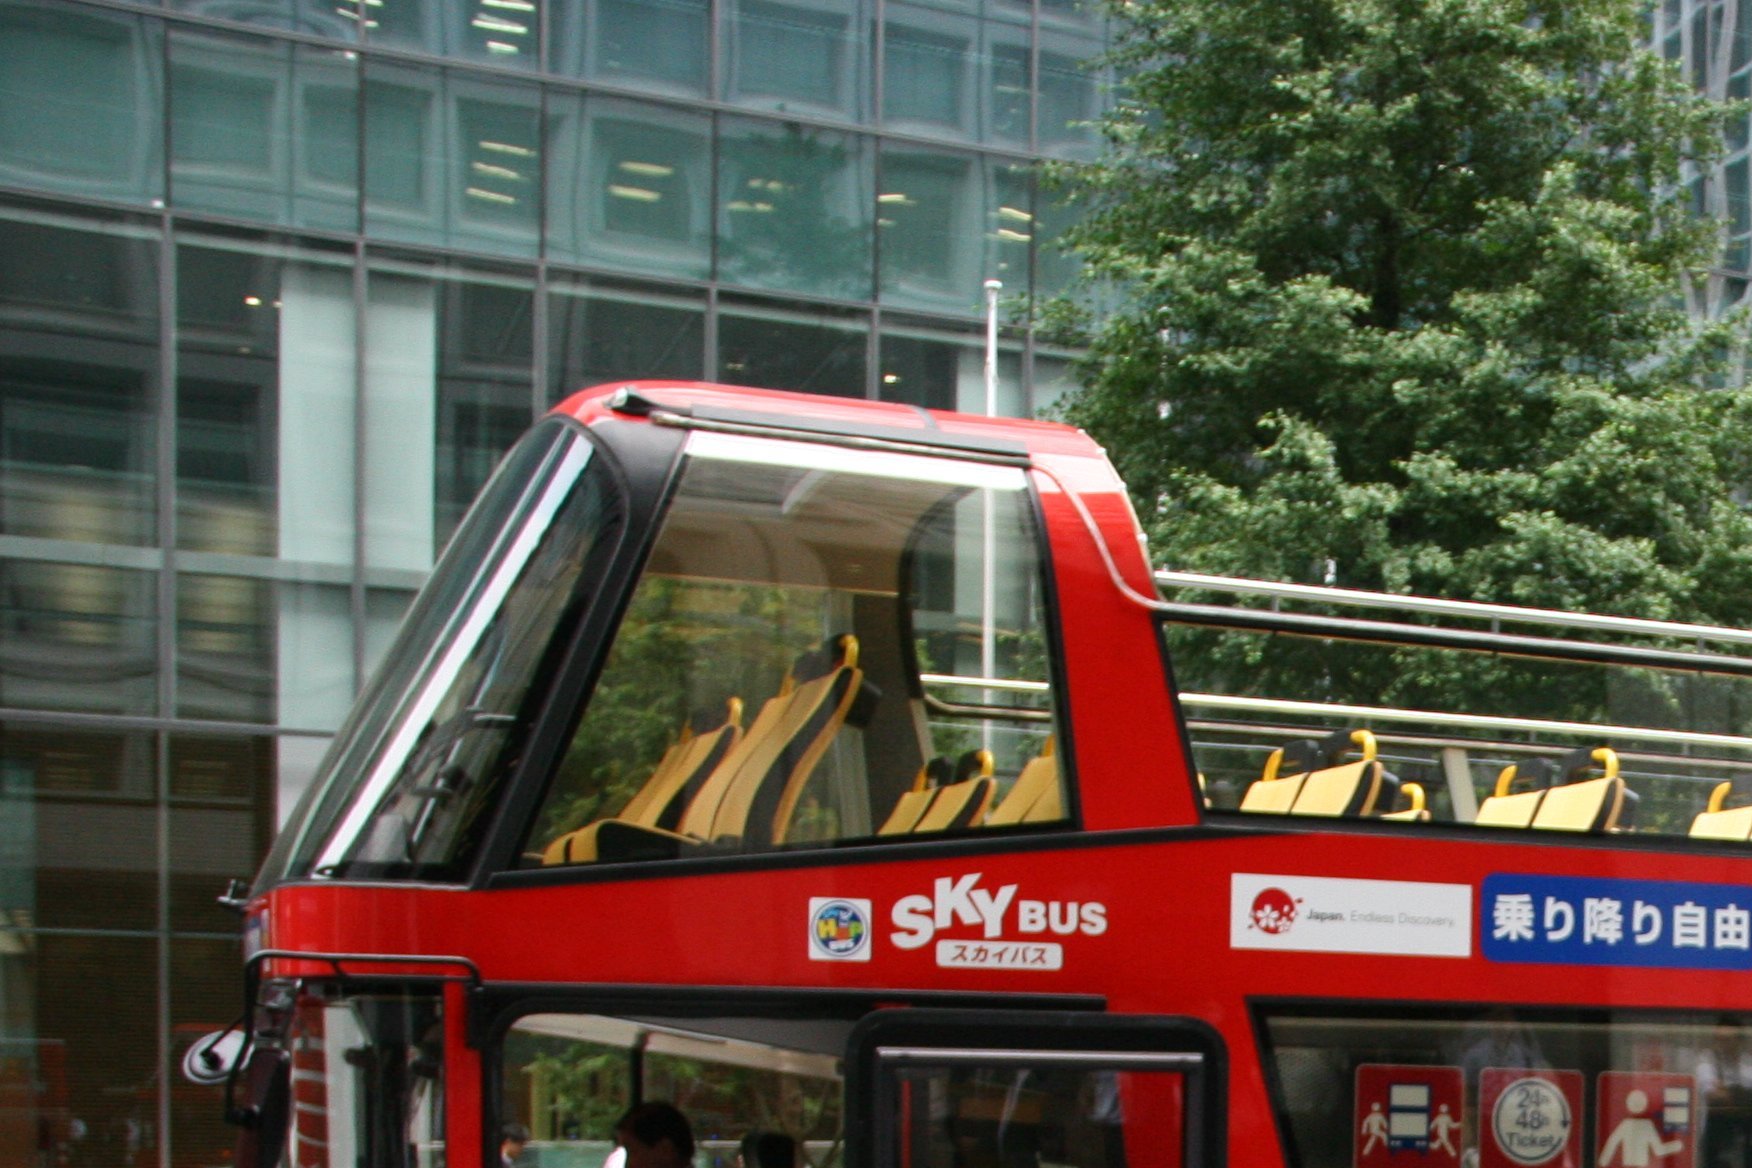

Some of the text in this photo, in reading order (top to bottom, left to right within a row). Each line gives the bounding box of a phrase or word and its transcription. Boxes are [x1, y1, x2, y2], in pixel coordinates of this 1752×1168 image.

[890, 872, 1107, 950] SKY BUS
[1492, 892, 1752, 950] 乗り降り自由
[951, 944, 1048, 965] スカイバス
